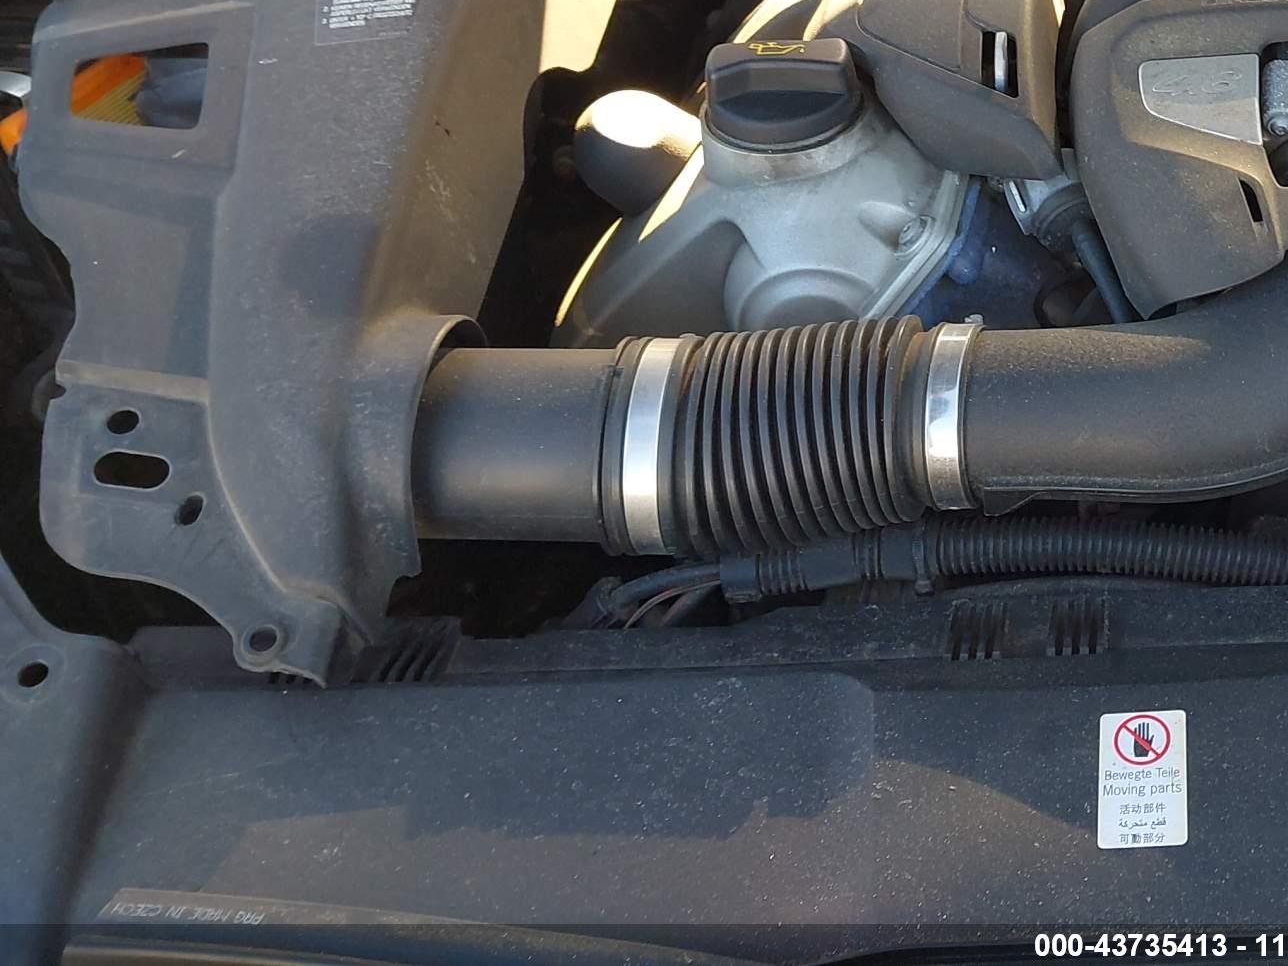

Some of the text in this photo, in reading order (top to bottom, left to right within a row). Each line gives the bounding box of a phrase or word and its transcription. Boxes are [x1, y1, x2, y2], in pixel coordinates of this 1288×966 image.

[1104, 766, 1180, 782] Bewegte Teile
[1103, 781, 1182, 797] Moving parts
[1119, 802, 1166, 815] 活动部件
[1119, 832, 1166, 845] 可動部分
